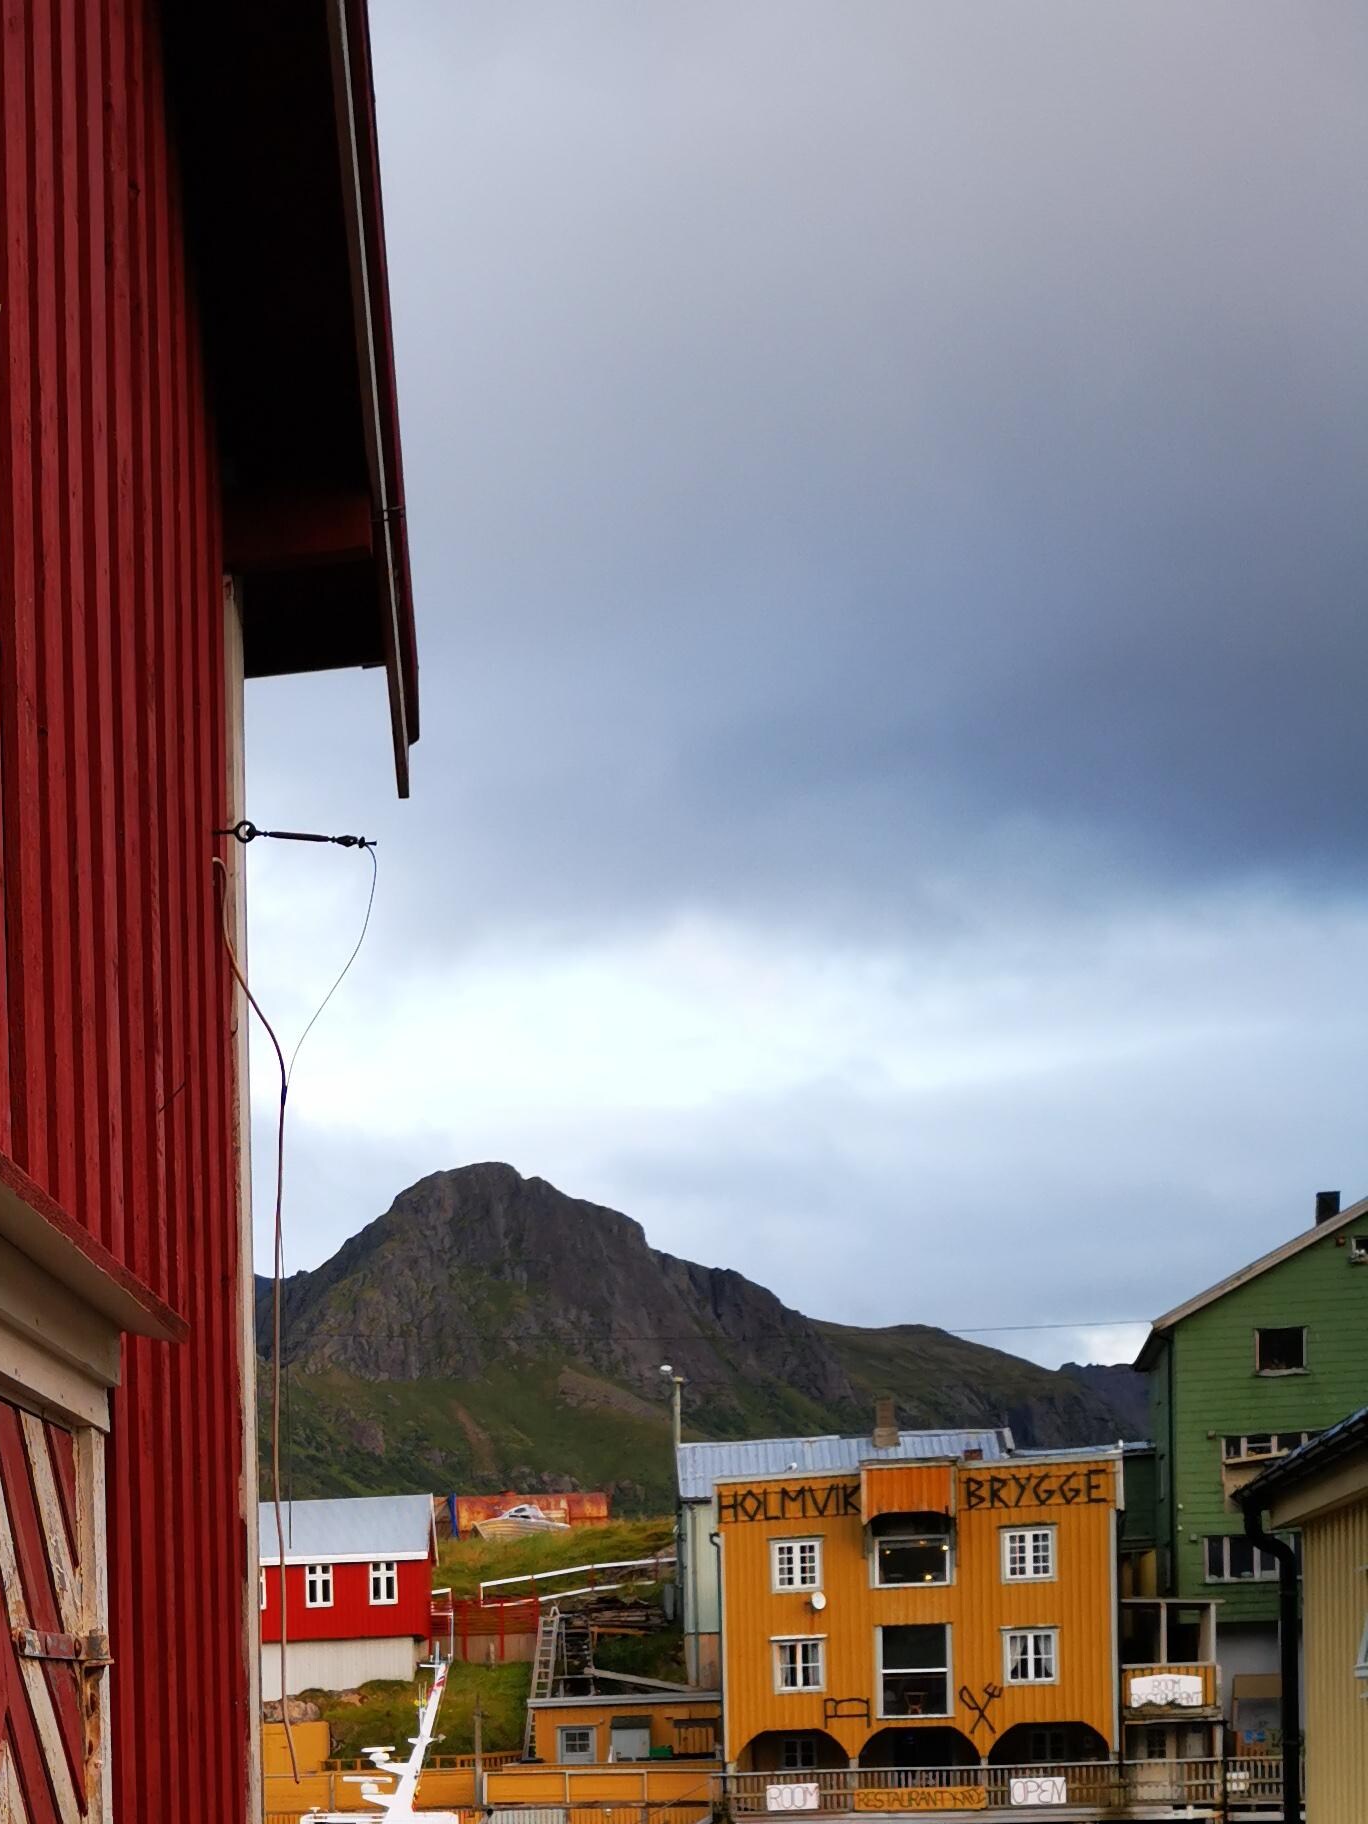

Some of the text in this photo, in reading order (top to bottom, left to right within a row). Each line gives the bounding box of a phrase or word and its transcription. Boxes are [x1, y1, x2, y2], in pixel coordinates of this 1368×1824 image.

[718, 1469, 1107, 1523] HOLMVIK BRYGGE
[767, 1785, 819, 1809] ROOM
[856, 1790, 949, 1808] RESTAURANT
[1012, 1780, 1066, 1805] OPEN
